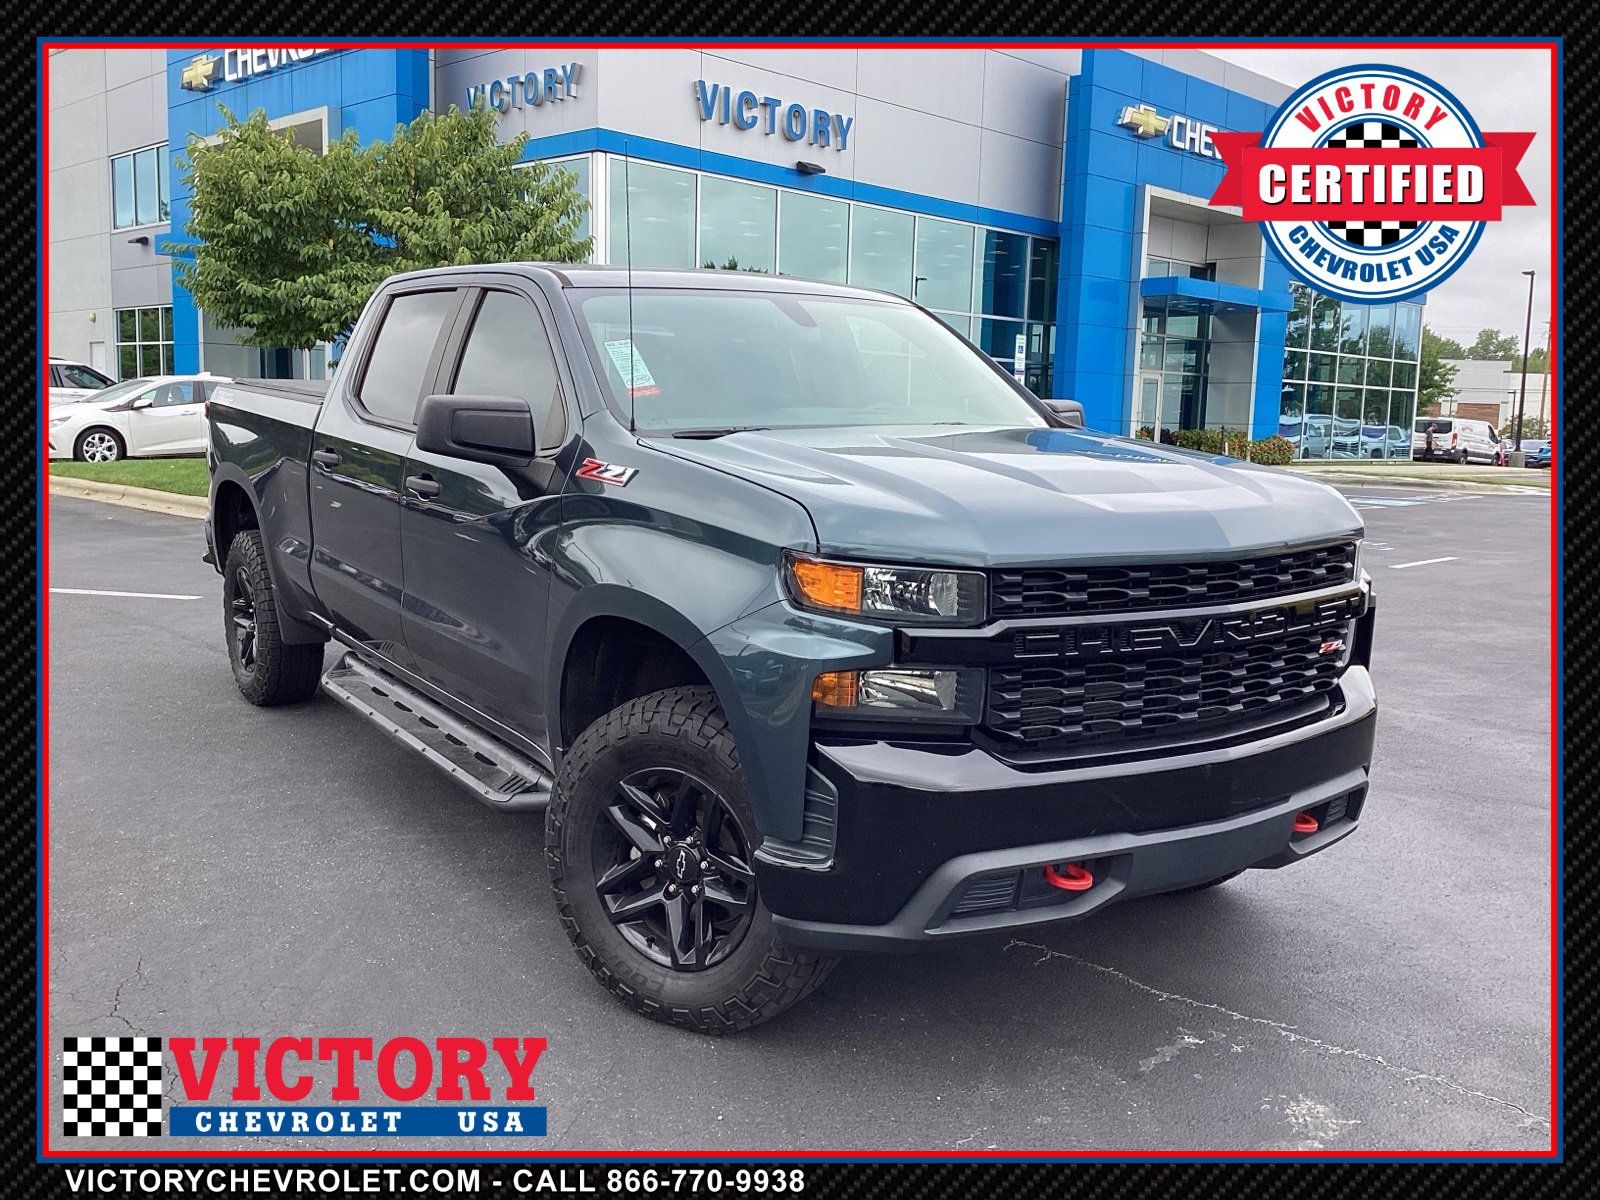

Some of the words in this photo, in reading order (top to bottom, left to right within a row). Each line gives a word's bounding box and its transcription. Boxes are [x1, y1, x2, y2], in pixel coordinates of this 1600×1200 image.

[695, 79, 853, 151] VICTORY
[1170, 115, 1222, 159] CHE
[575, 457, 639, 487] Z71
[1013, 597, 1360, 658] CHEVROLET
